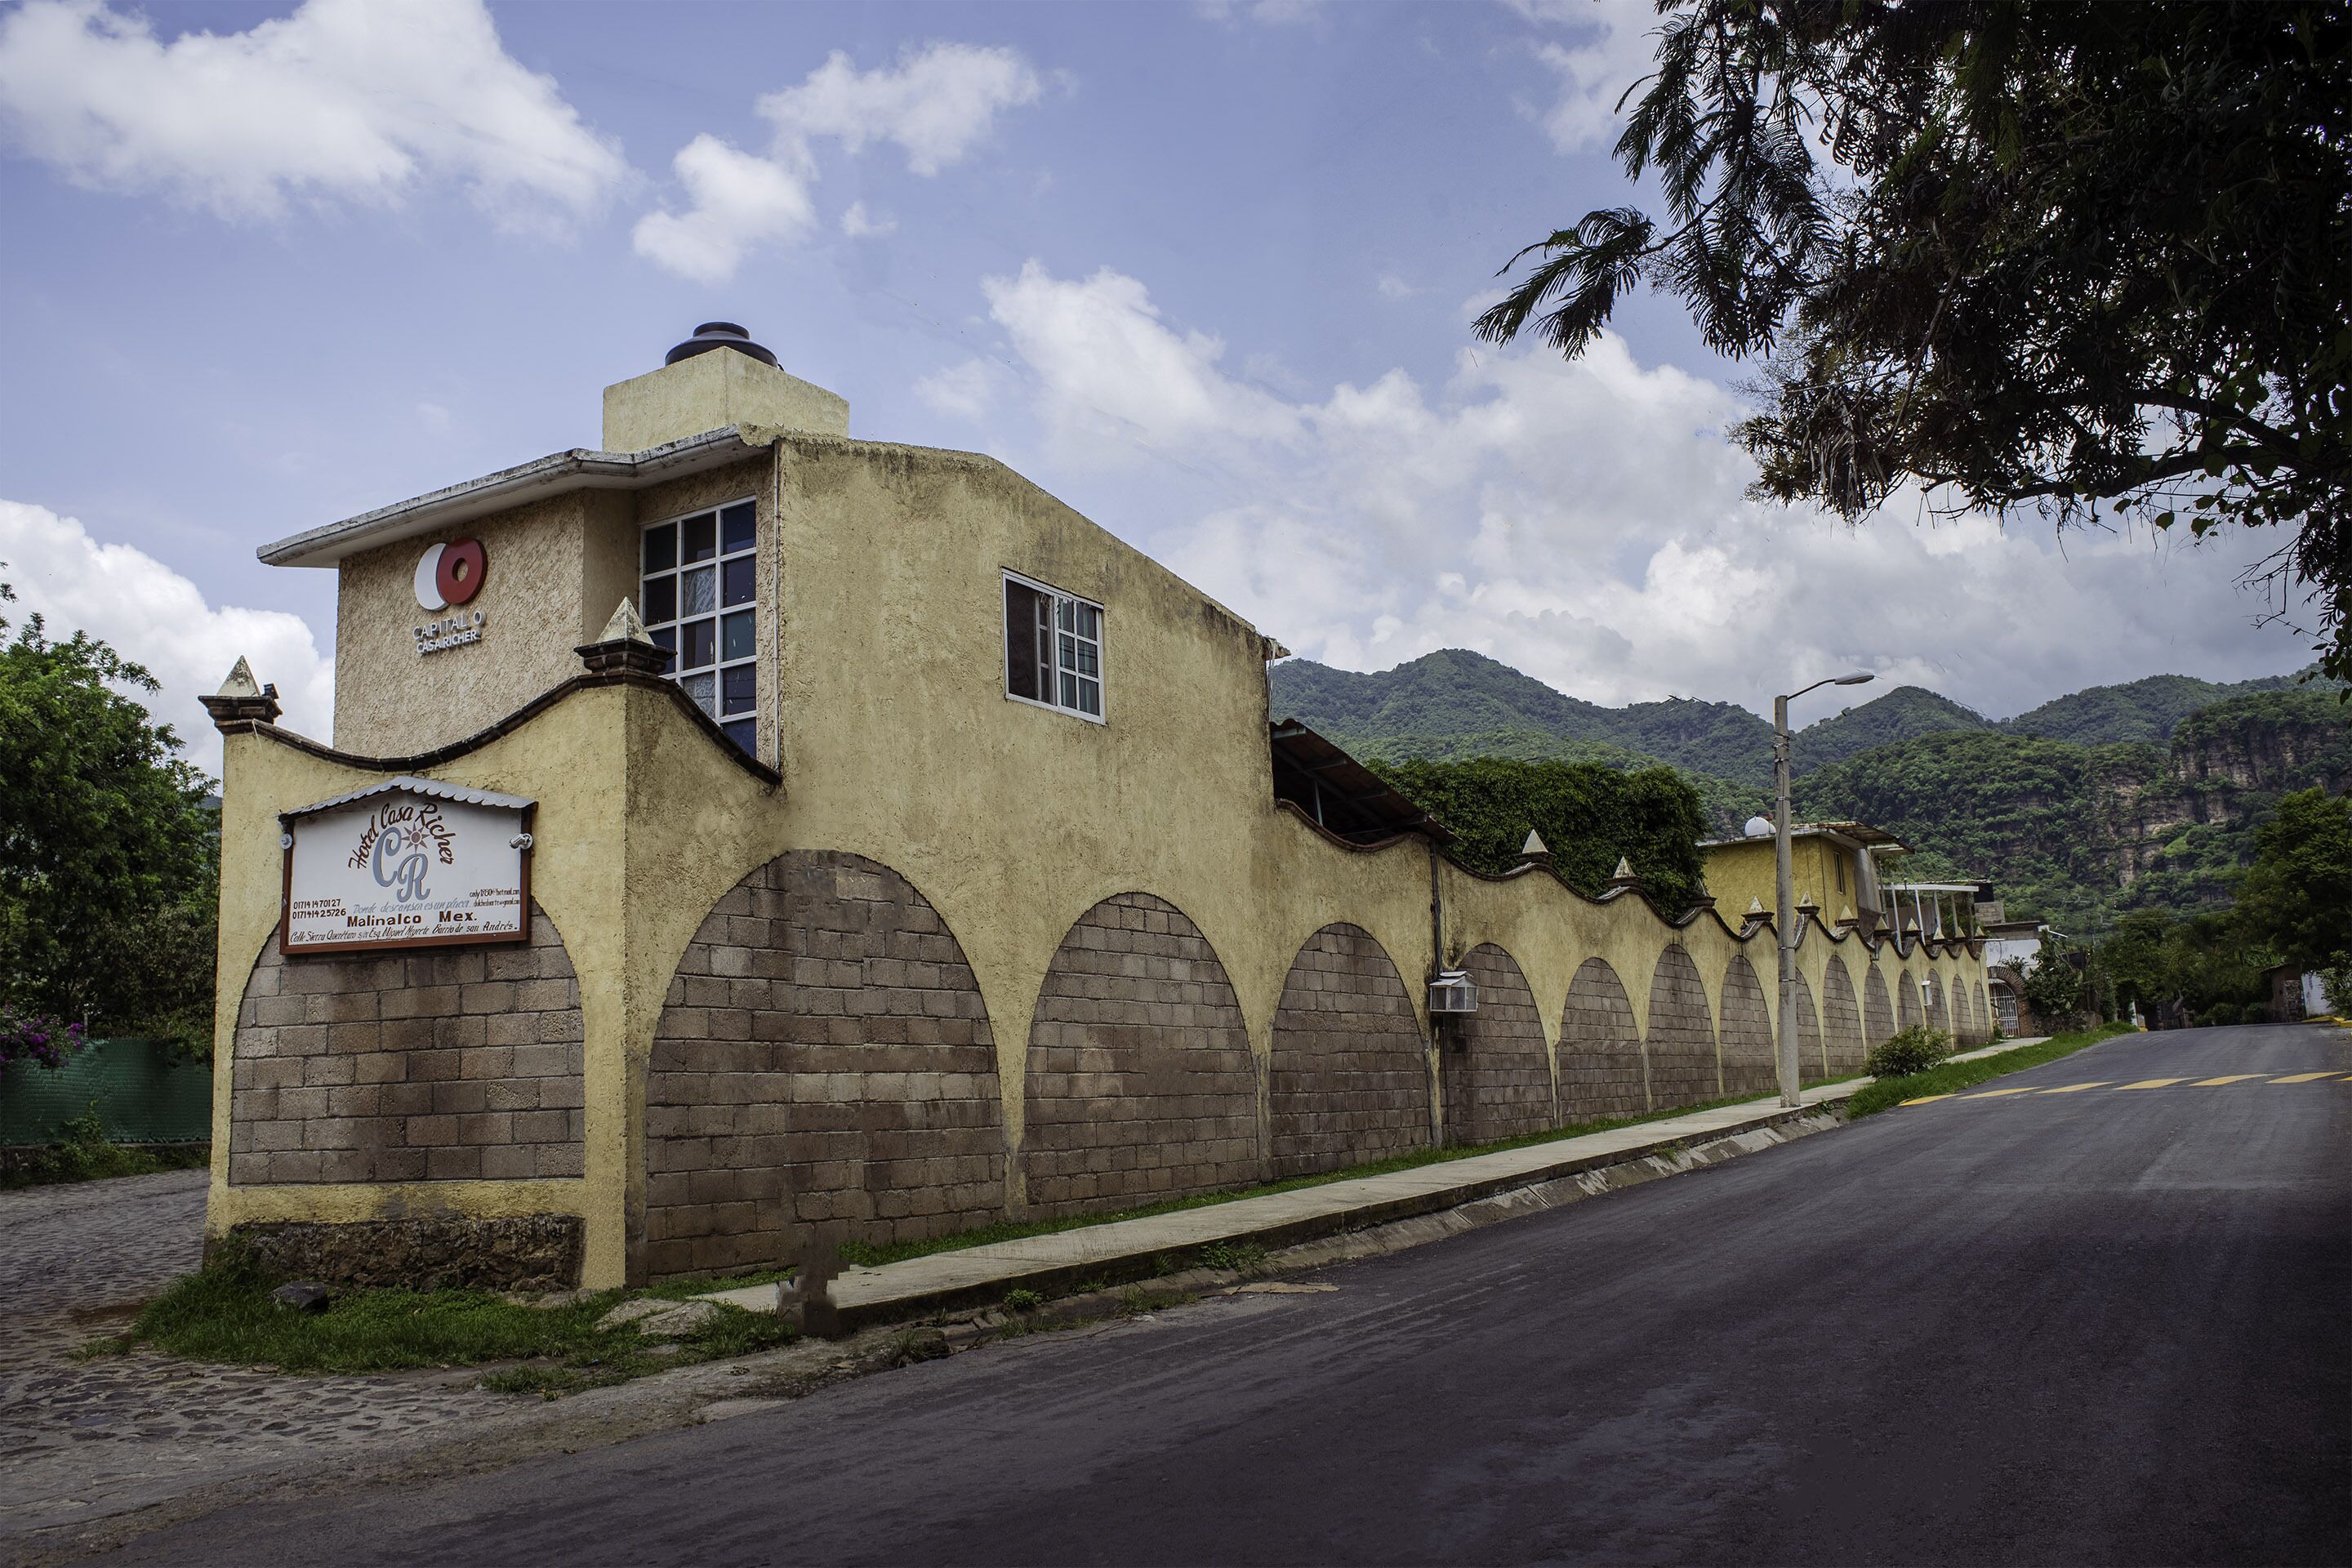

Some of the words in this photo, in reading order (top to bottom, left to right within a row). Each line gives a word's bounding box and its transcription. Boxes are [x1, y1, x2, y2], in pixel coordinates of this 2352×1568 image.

[412, 614, 468, 640] CAPITAL
[416, 639, 442, 654] CASA
[443, 630, 479, 648] RICHER
[348, 814, 379, 869] Hotel
[381, 803, 414, 829] Casa
[415, 803, 457, 865] Richer
[347, 914, 422, 928] Malinalco
[439, 911, 478, 923] Mex.
[290, 931, 306, 942] Calle
[306, 930, 326, 942] Sierra
[382, 926, 408, 940] Miguel
[432, 923, 454, 934] Barrio
